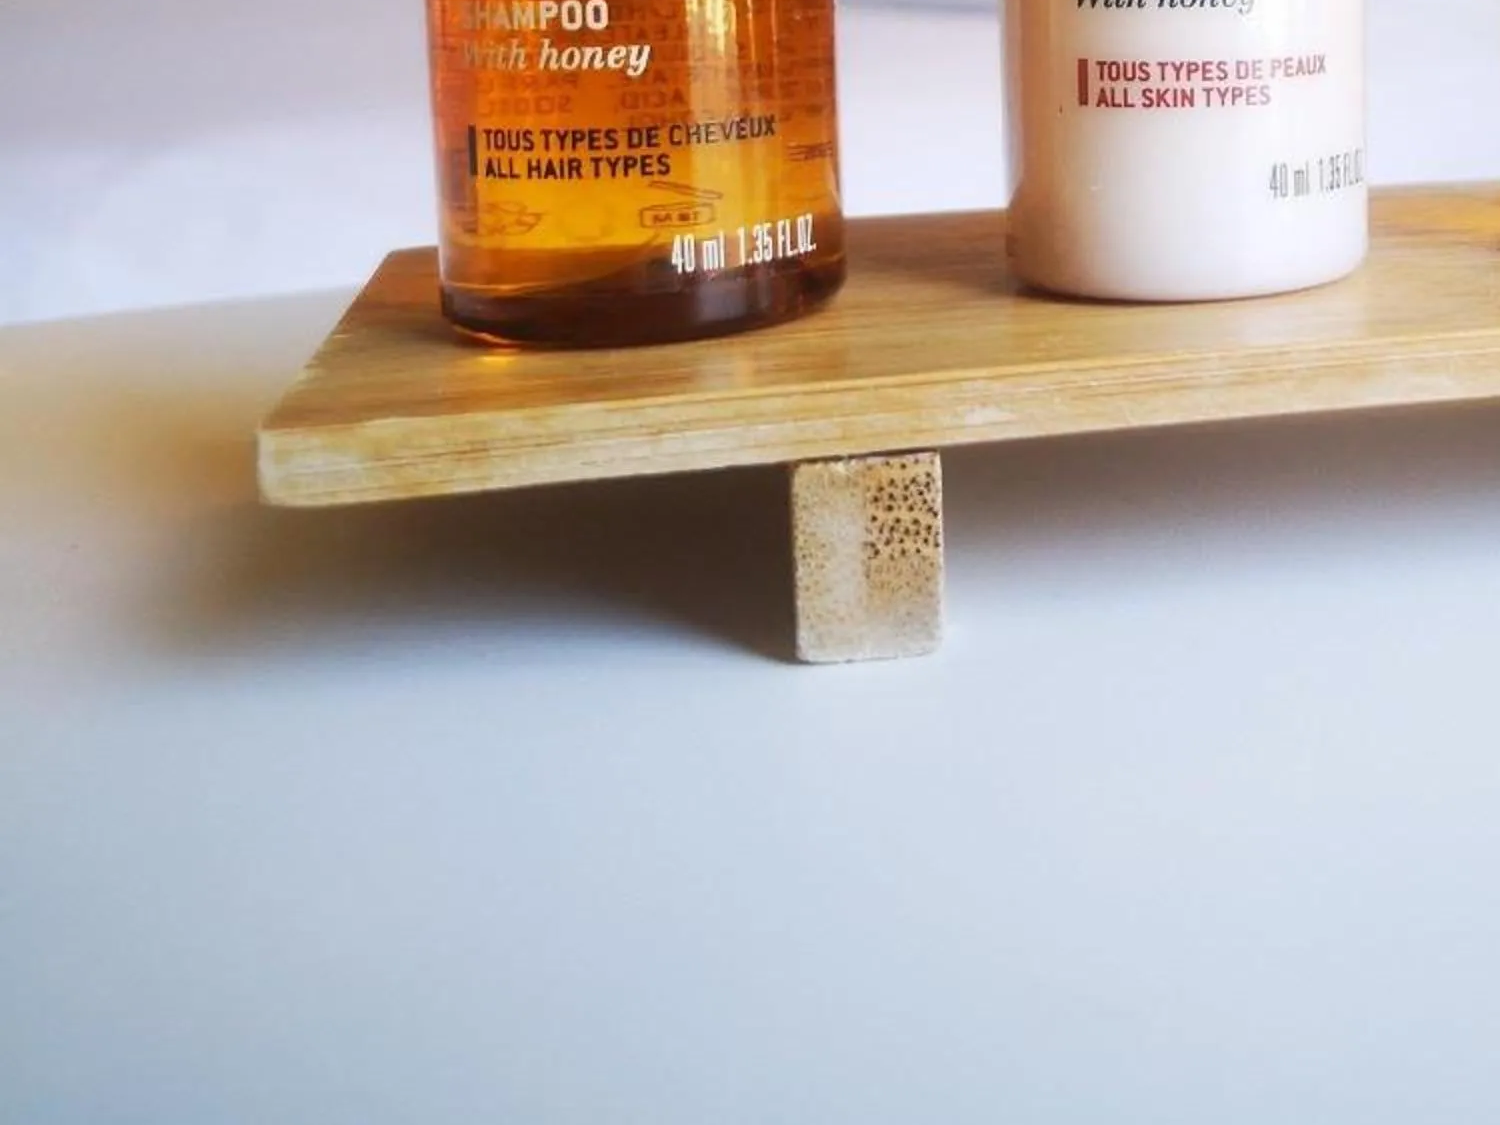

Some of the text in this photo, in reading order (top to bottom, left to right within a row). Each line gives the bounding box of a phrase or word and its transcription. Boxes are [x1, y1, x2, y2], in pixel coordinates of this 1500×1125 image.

[539, 38, 650, 77] honey
[1096, 54, 1326, 82] TOUS TYPES DE PEAUX
[1095, 85, 1272, 108] ALL SKIN TYPES
[483, 116, 776, 152] TOUS TYPES DE CHEVEUX
[483, 153, 671, 180] ALL HAIR TYPES
[1269, 162, 1288, 199] 40
[671, 234, 695, 274] 40
[702, 230, 725, 271] ml
[737, 222, 773, 266] 1.35
